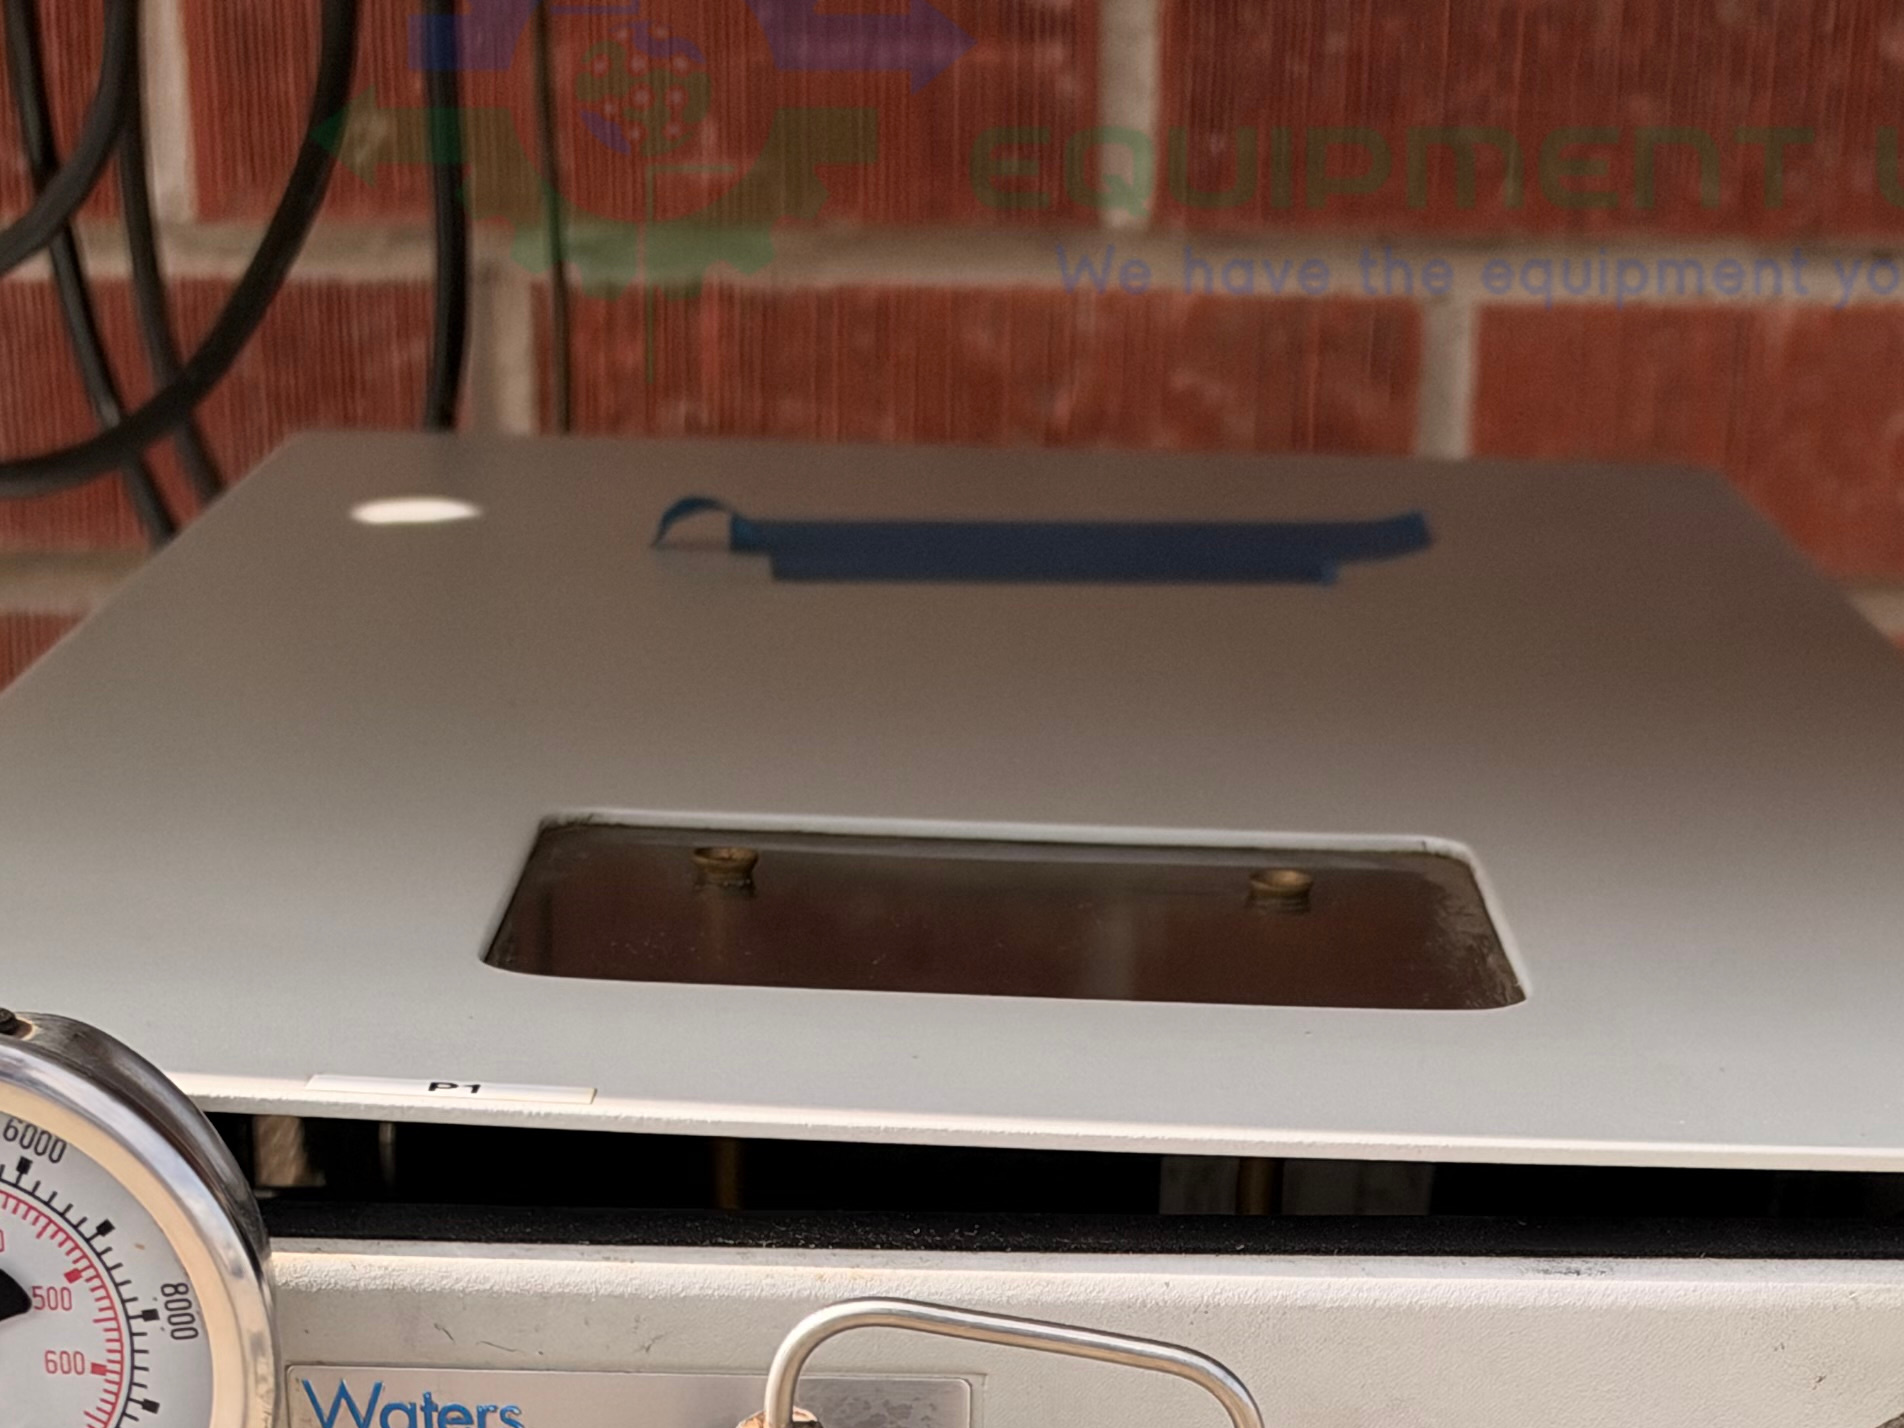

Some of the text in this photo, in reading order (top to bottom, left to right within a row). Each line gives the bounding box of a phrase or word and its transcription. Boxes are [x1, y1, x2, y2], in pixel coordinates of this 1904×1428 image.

[428, 1081, 482, 1095] P1
[2, 1116, 67, 1163] 6000
[32, 1285, 72, 1312] 500
[160, 1281, 199, 1340] 8000
[44, 1350, 85, 1375] 600
